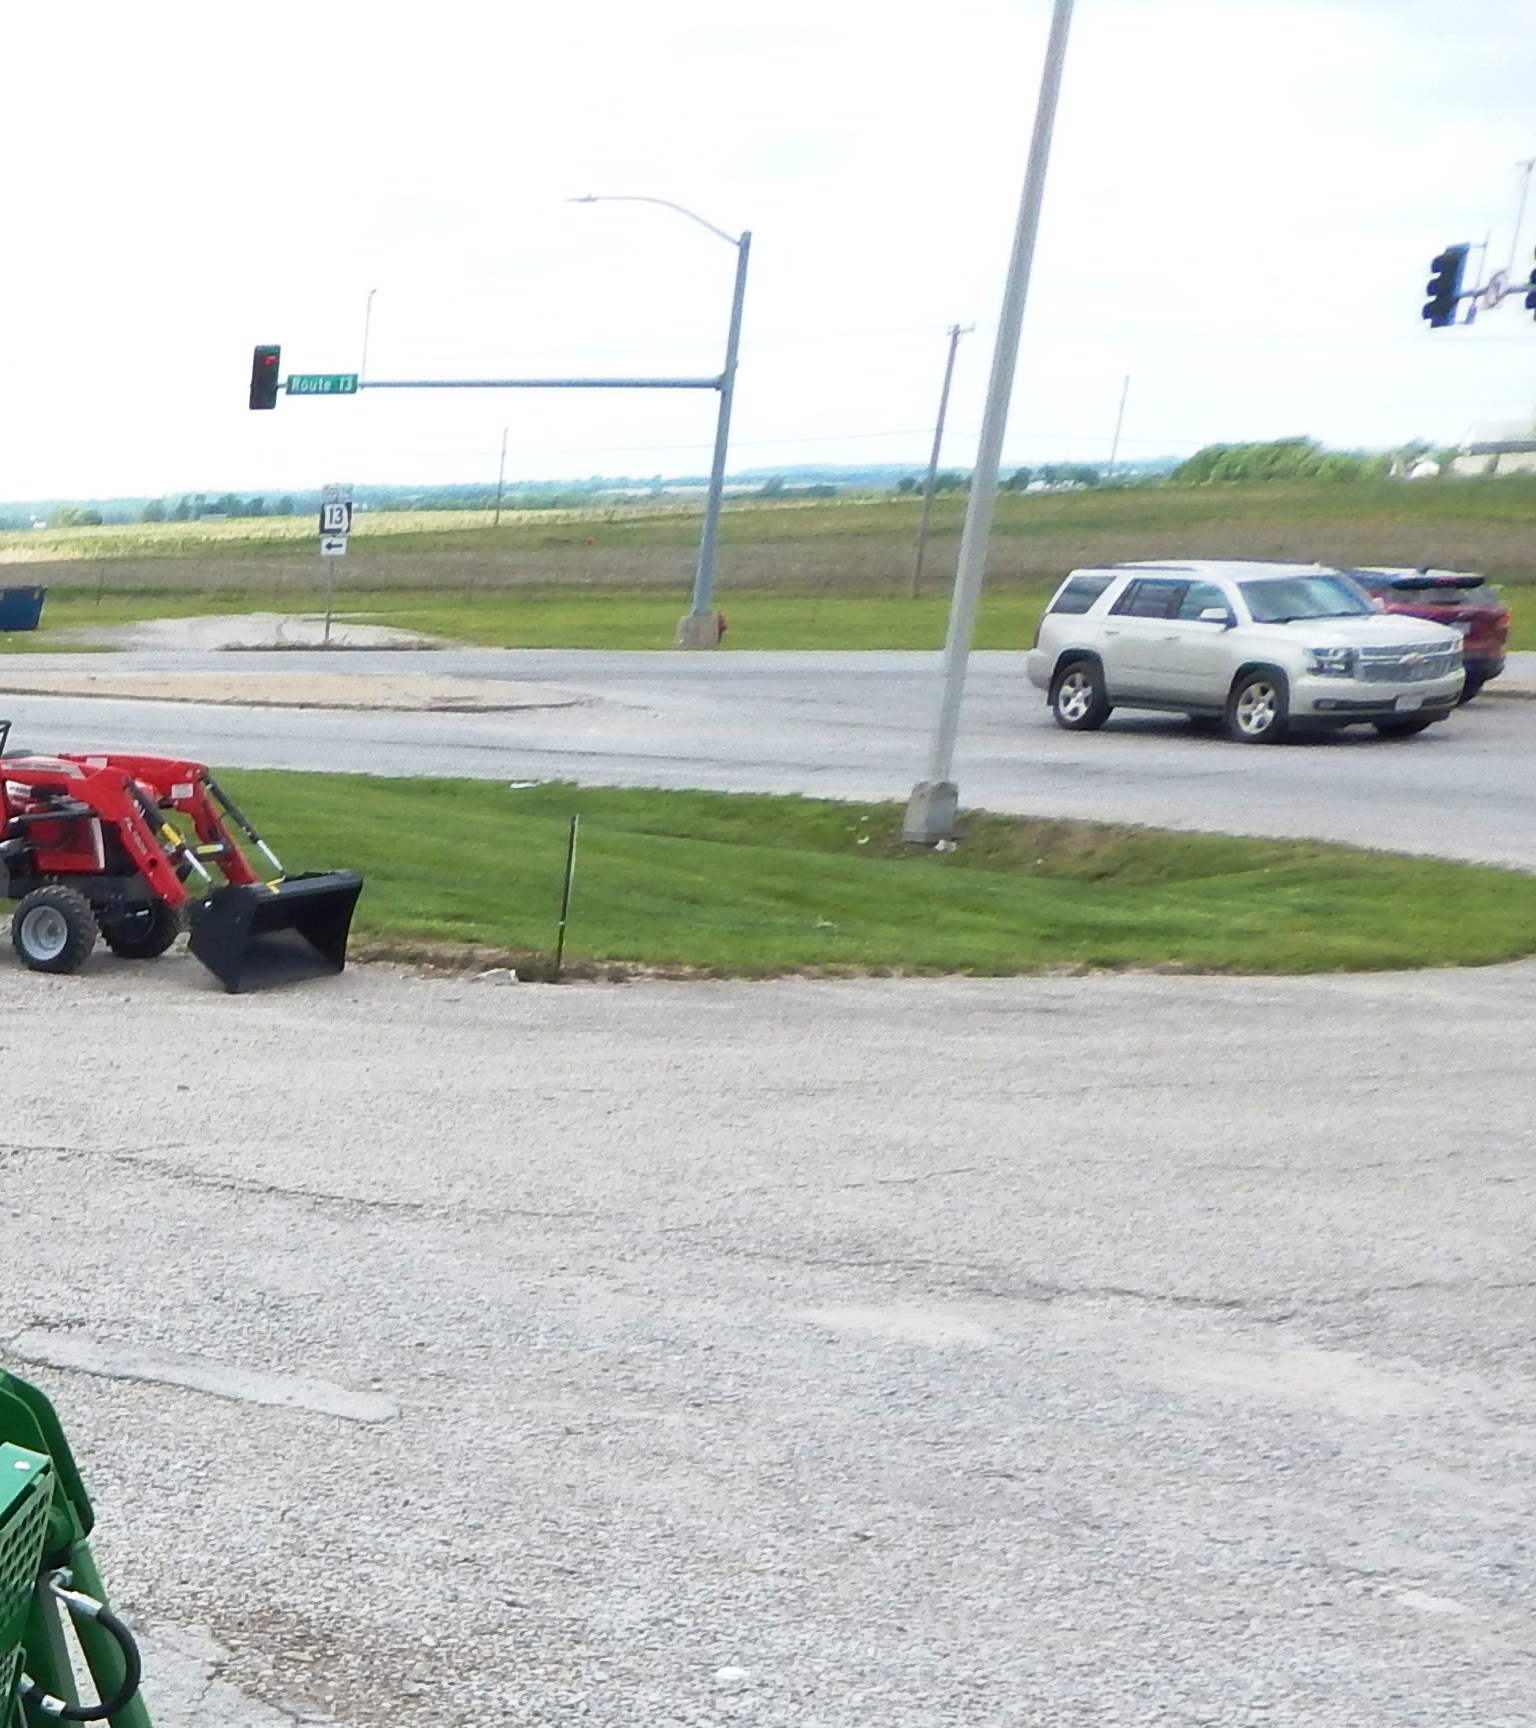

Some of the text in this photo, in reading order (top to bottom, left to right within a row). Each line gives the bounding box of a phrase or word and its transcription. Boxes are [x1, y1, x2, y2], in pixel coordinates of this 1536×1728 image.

[291, 376, 354, 391] Route 13
[329, 507, 344, 525] 13
